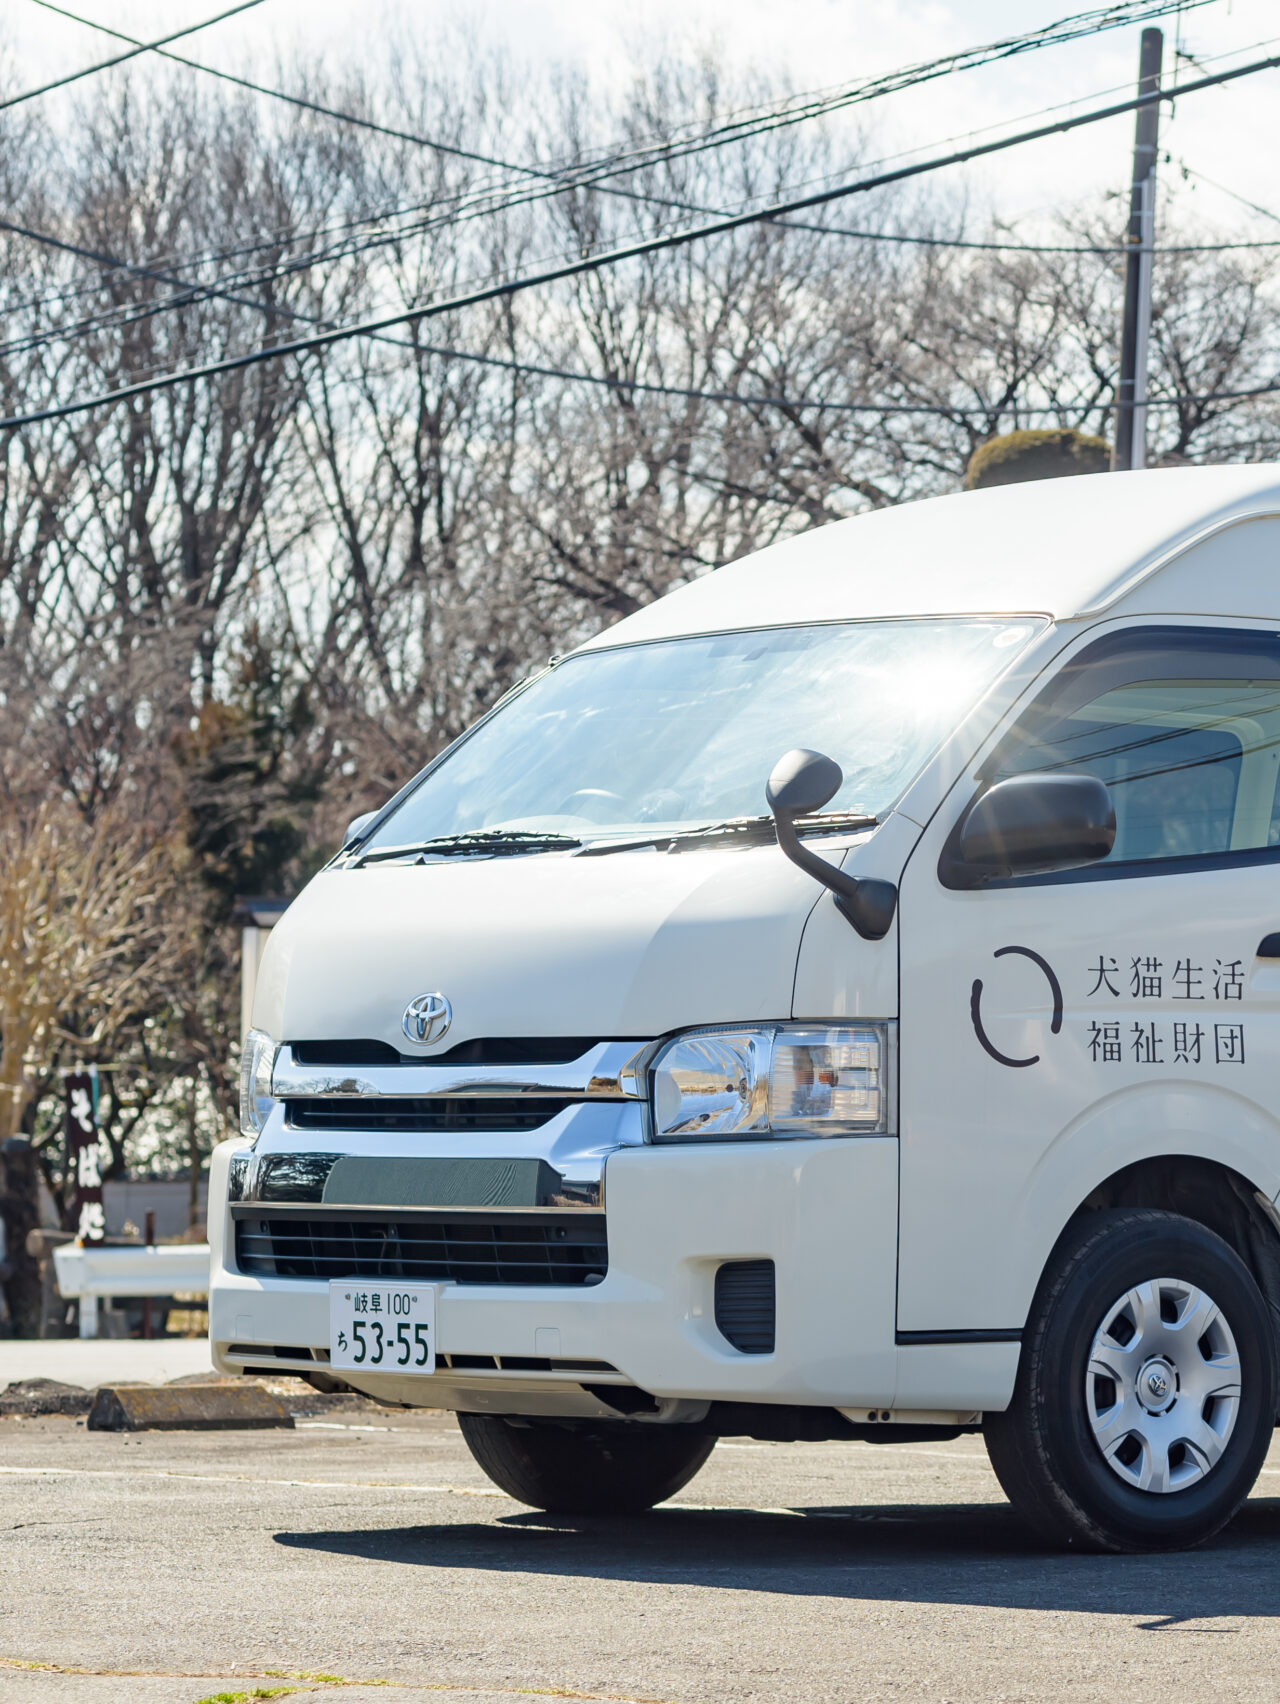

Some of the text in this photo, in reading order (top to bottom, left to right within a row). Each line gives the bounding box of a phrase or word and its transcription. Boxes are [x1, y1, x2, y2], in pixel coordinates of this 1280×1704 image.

[1086, 955, 1245, 1001] 犬猫生活
[1086, 1020, 1246, 1065] 福祉財団
[354, 1292, 411, 1316] 岐阜 100
[353, 1320, 429, 1367] 53-55
